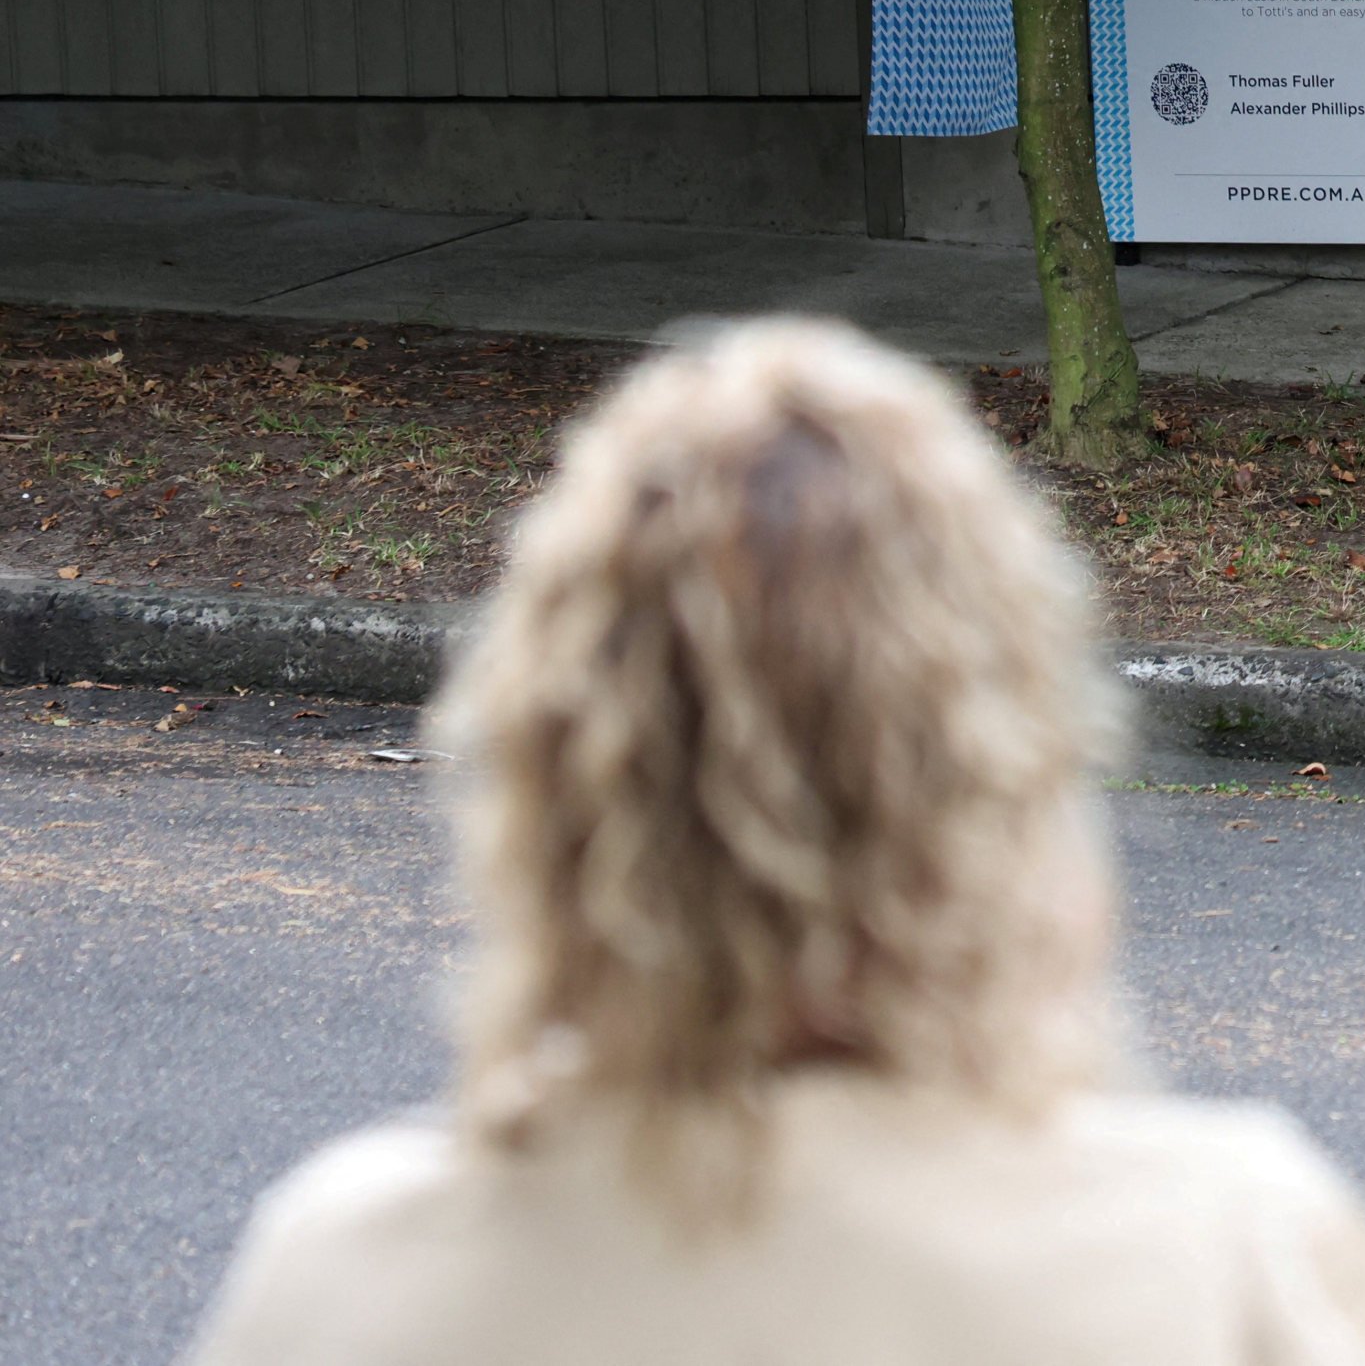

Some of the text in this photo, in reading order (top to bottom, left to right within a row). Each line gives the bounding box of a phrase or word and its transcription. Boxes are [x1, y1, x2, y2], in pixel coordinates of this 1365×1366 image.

[1242, 7, 1254, 17] to
[1257, 6, 1293, 17] Totti's
[1297, 6, 1318, 17] and
[1322, 8, 1336, 17] an
[1340, 8, 1365, 18] easy
[1228, 74, 1334, 88] Thomas Fuller
[1231, 102, 1365, 117] Alexander Phillips
